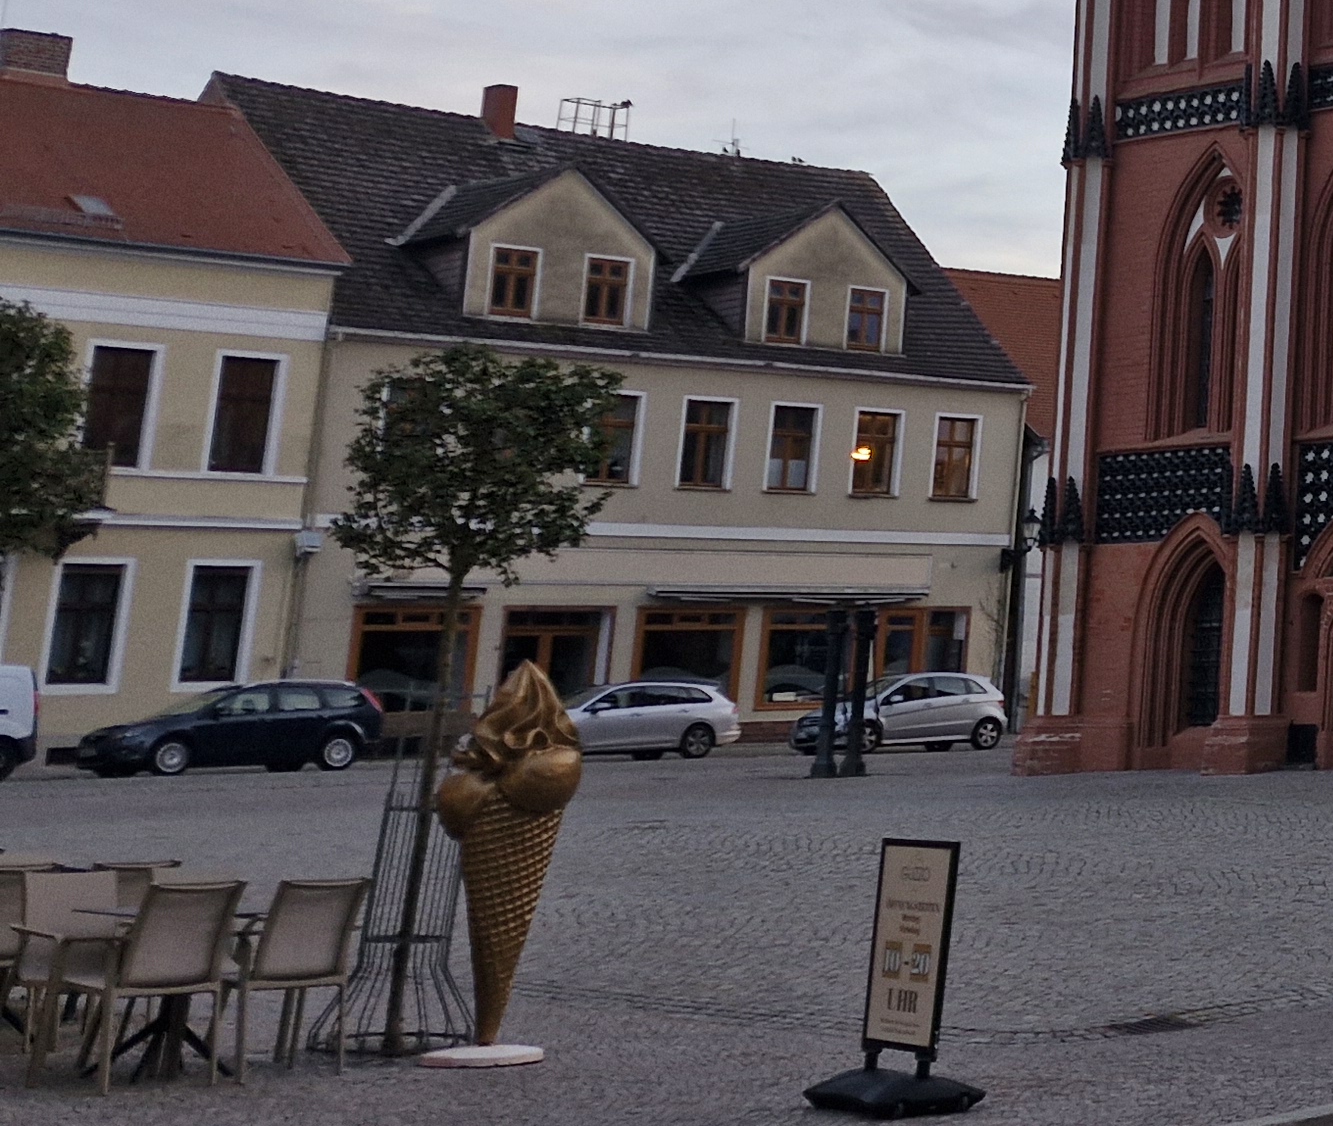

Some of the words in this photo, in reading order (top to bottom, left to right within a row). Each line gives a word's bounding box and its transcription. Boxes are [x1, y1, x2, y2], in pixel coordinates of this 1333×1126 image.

[884, 950, 900, 973] 10
[910, 952, 931, 975] 20
[887, 987, 918, 1014] UHR
